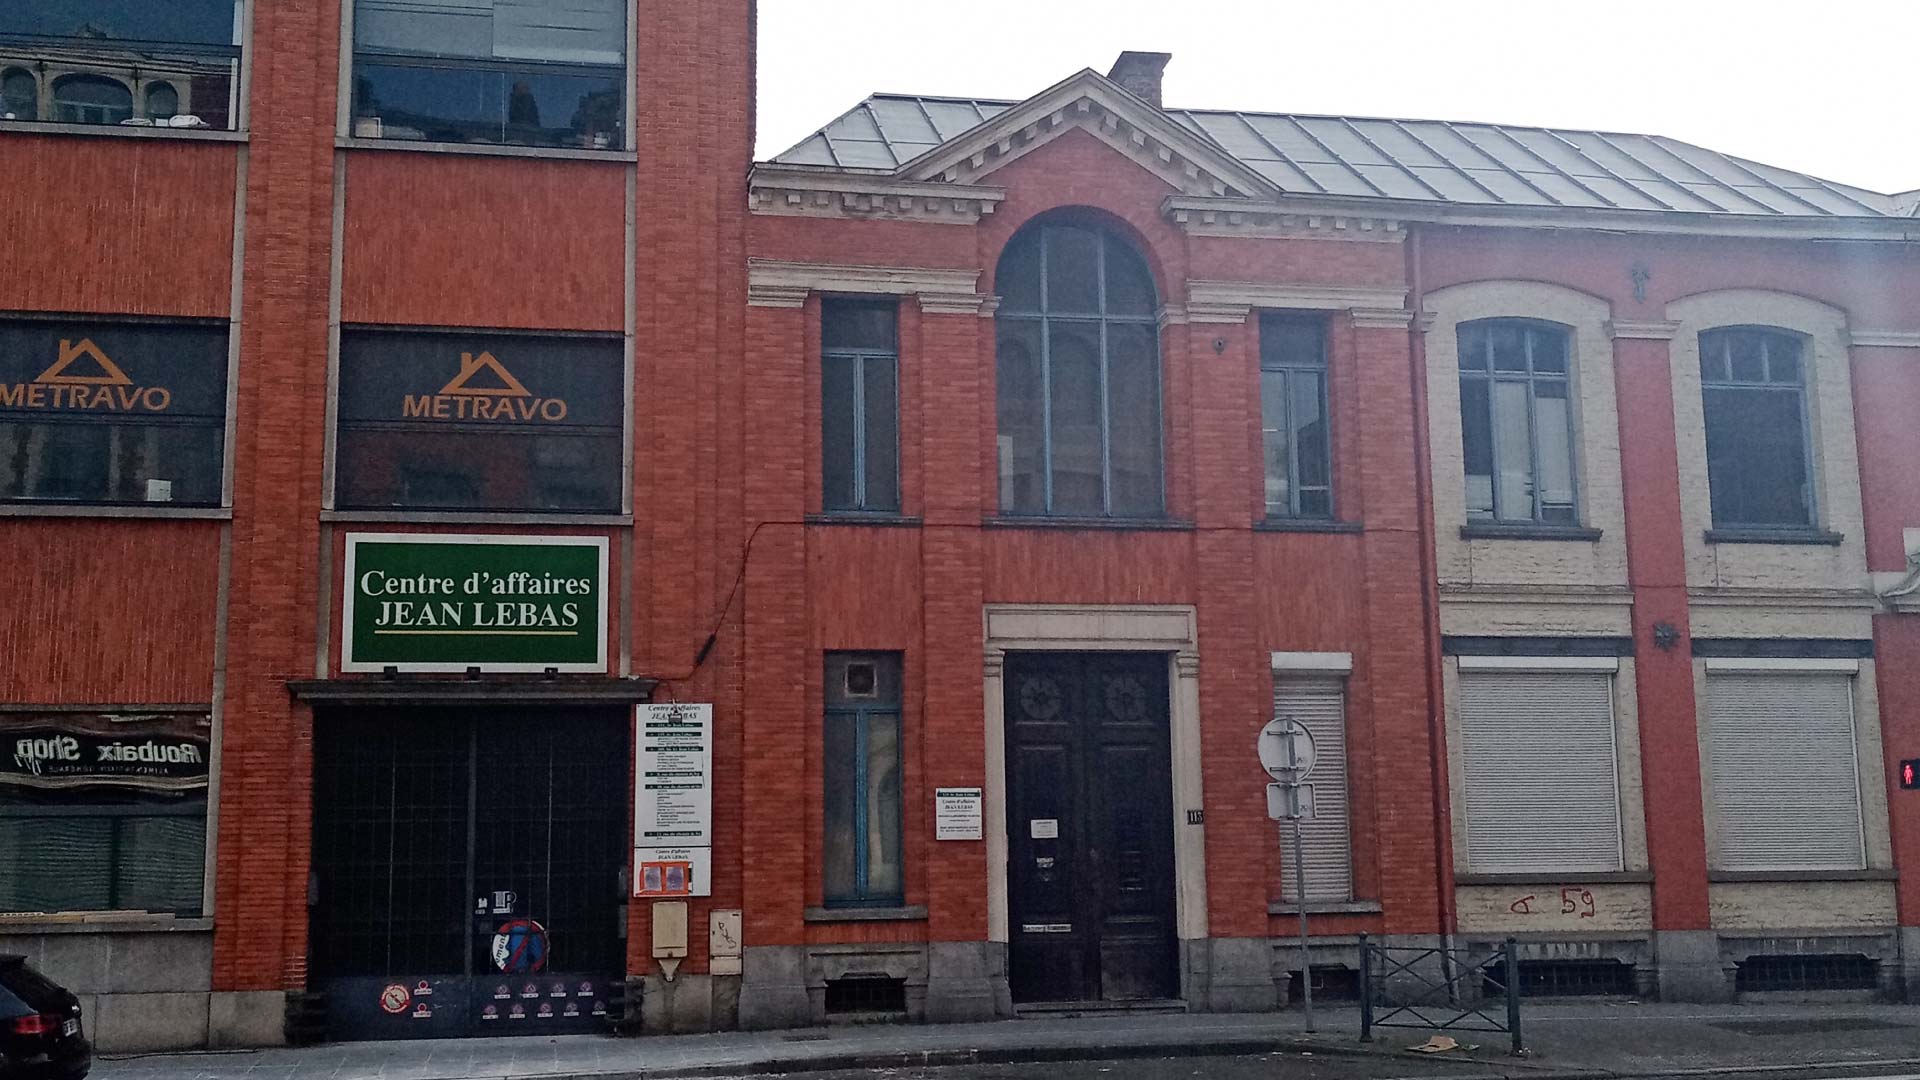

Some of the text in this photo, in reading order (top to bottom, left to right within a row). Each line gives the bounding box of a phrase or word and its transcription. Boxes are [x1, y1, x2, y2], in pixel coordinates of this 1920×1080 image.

[0, 383, 171, 411] METRAVO
[402, 394, 568, 421] METRAVO
[361, 570, 591, 596] Centre d'affaires
[375, 601, 579, 627] JEAN LEBAS
[1561, 887, 1595, 919] 59
